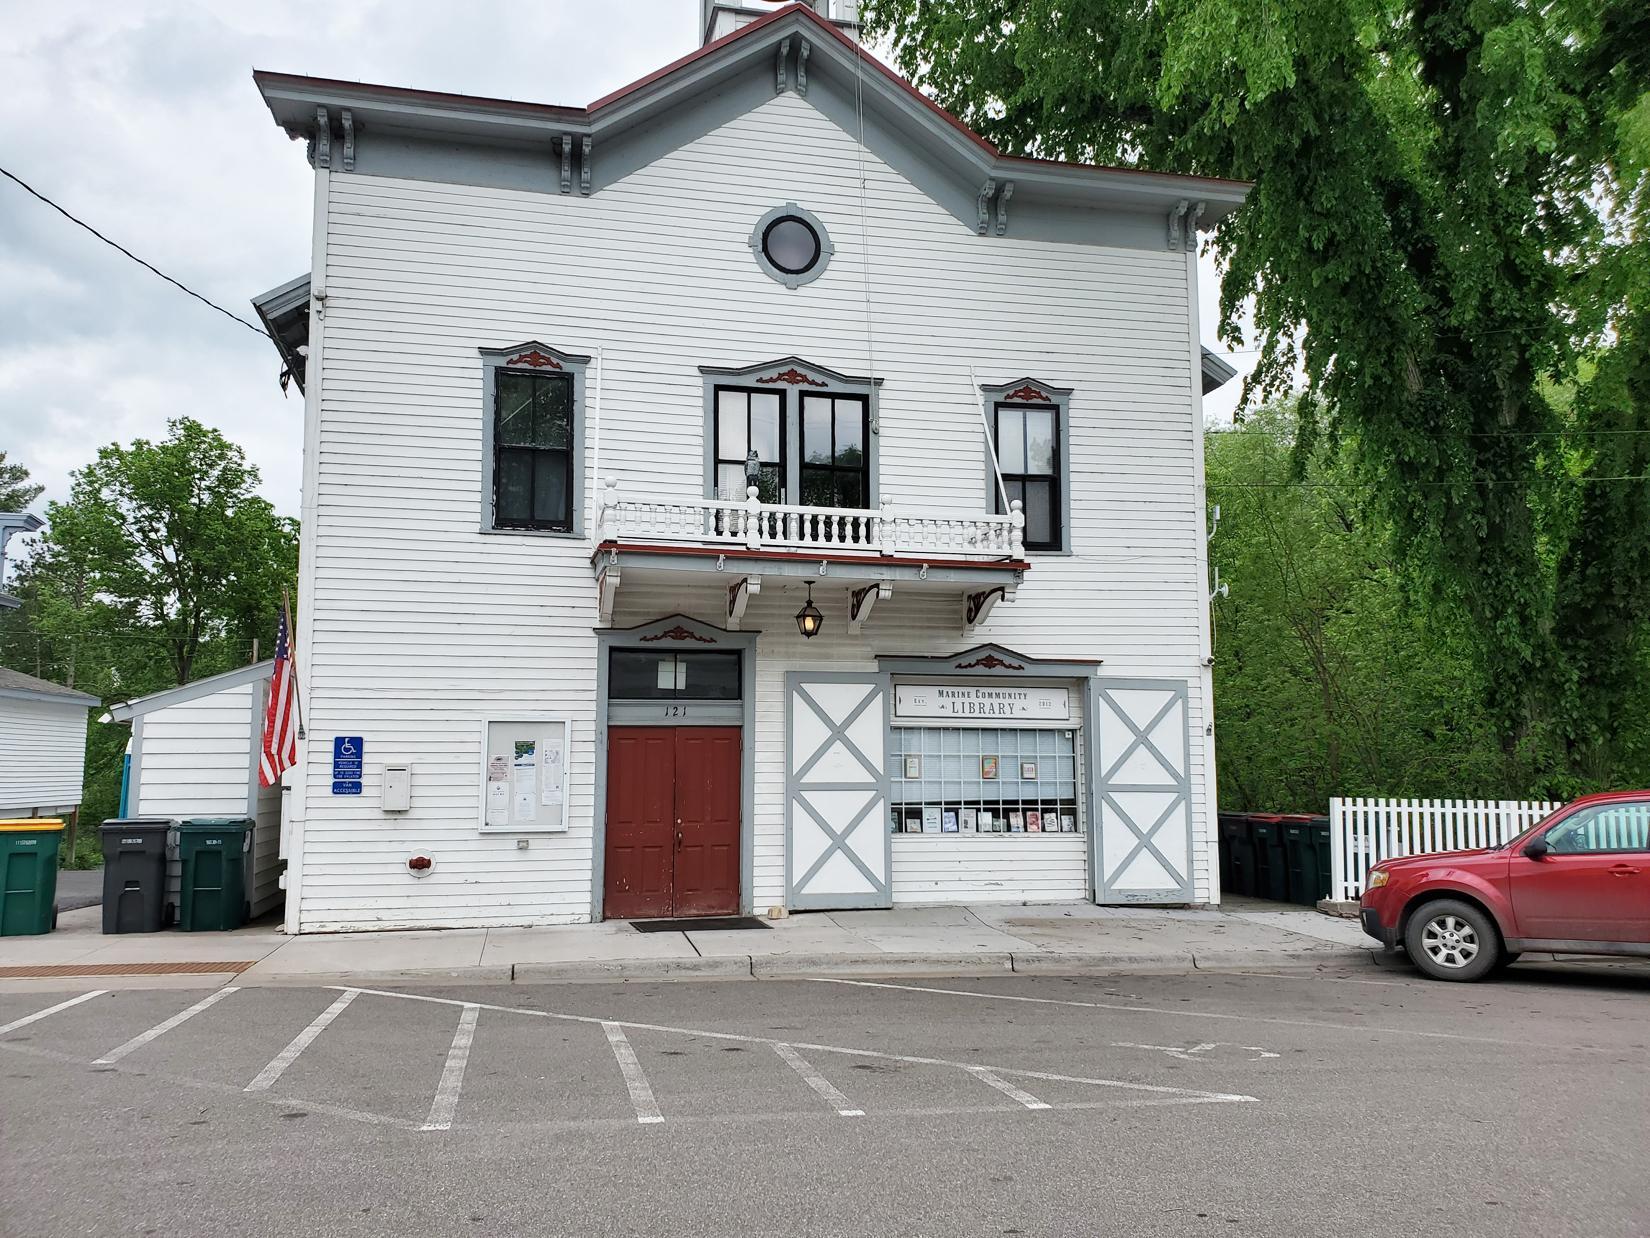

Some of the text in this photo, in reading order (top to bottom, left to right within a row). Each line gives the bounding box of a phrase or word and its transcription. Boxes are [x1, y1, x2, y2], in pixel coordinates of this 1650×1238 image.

[938, 689, 1028, 700] MARINE COMMUNITY
[665, 706, 687, 717] 121
[951, 701, 1015, 715] LIBRARY
